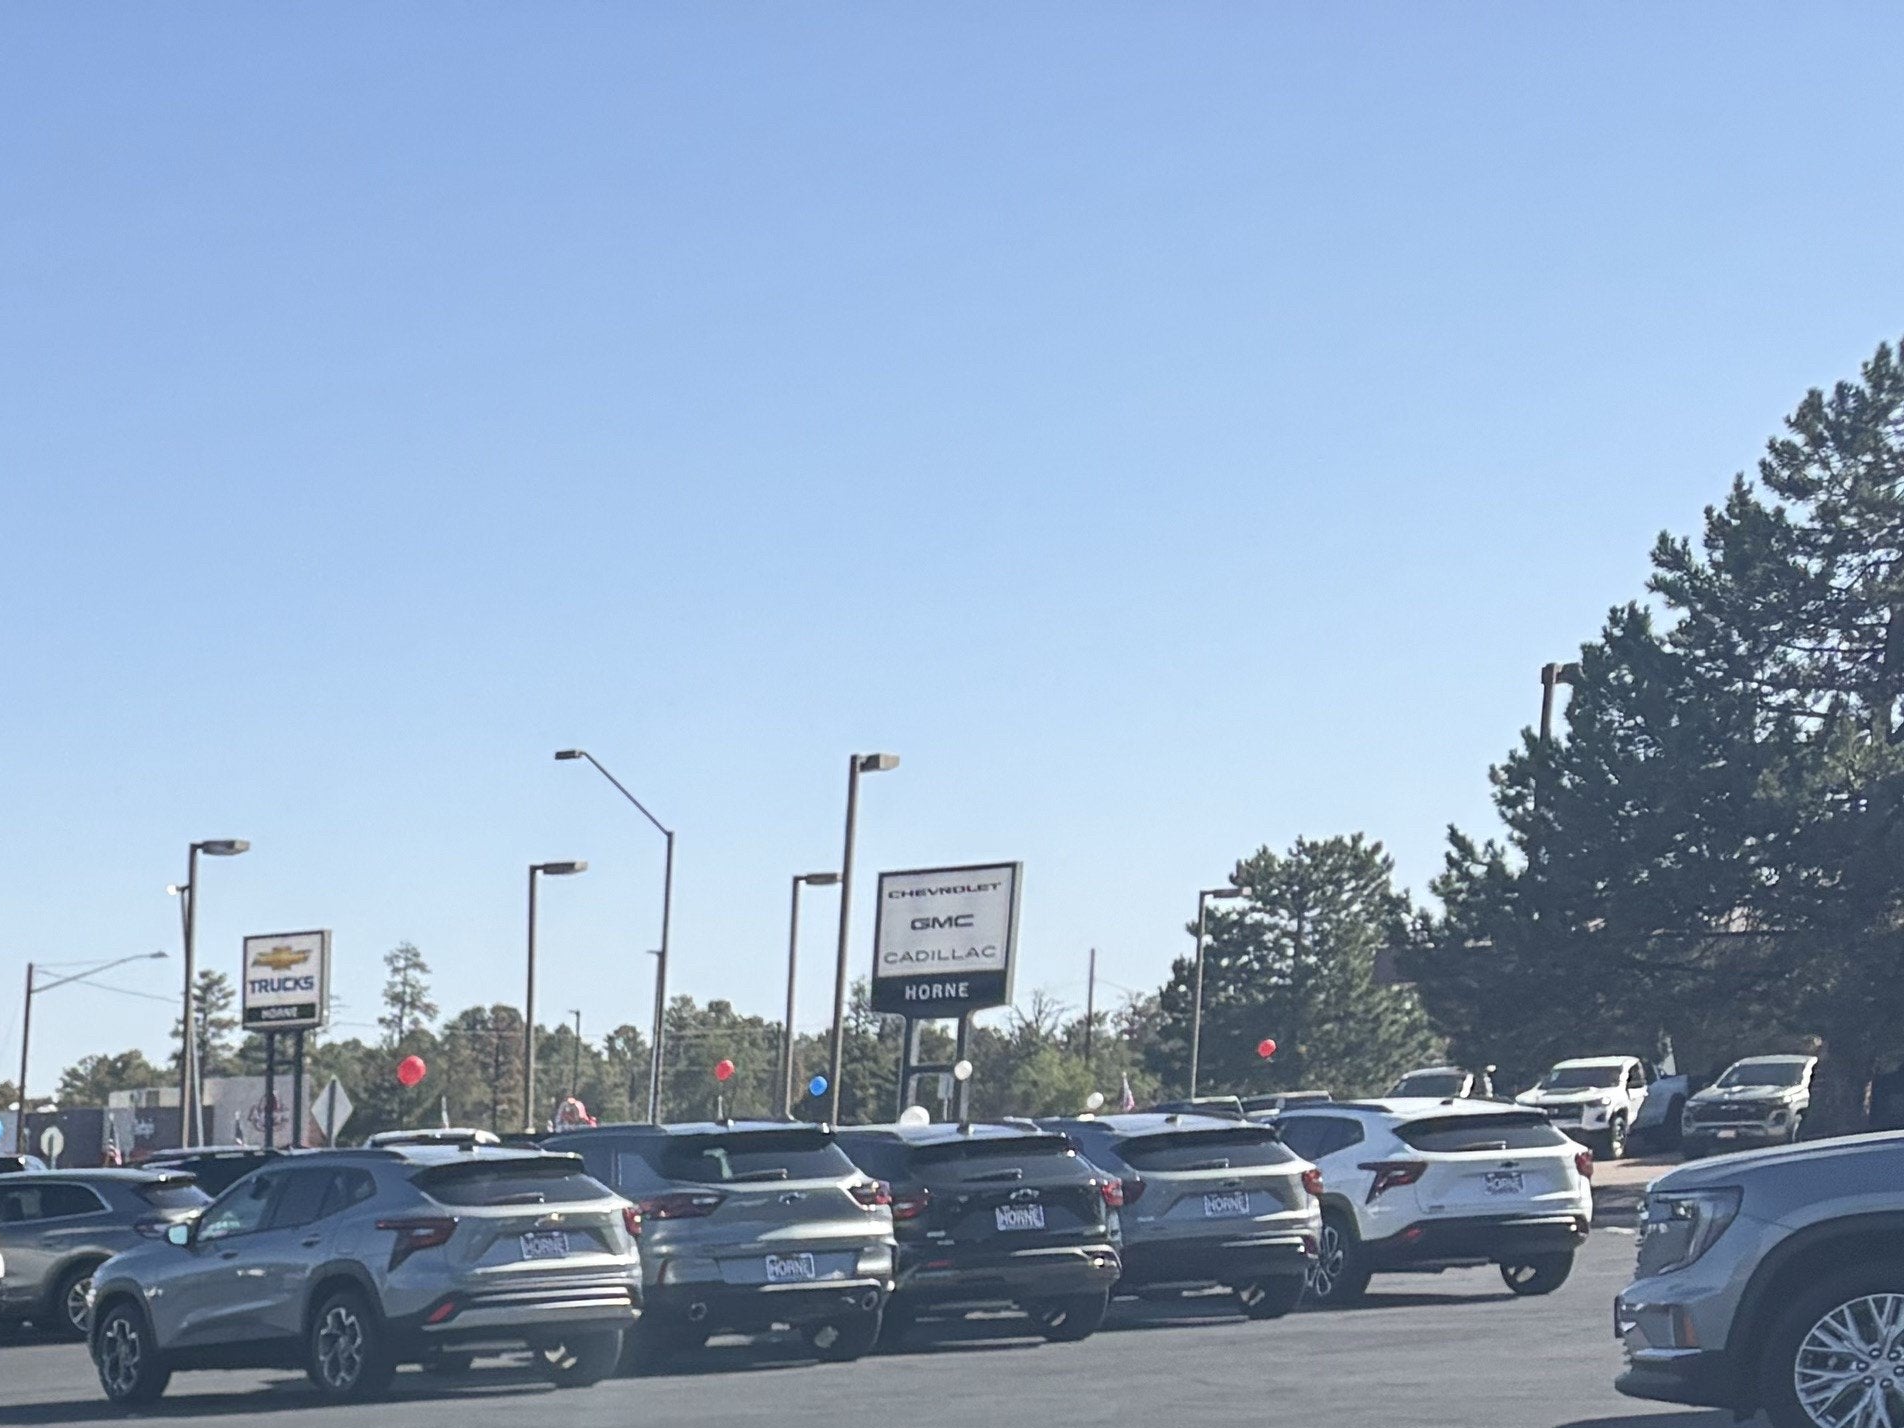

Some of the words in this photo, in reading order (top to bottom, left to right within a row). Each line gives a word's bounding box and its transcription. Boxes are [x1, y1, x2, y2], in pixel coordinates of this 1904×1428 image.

[888, 882, 1002, 899] CHEVROLET
[910, 913, 974, 931] GMC
[884, 945, 996, 964] CADILLAC
[249, 975, 313, 993] TRUCKS
[905, 982, 970, 1000] HORNE
